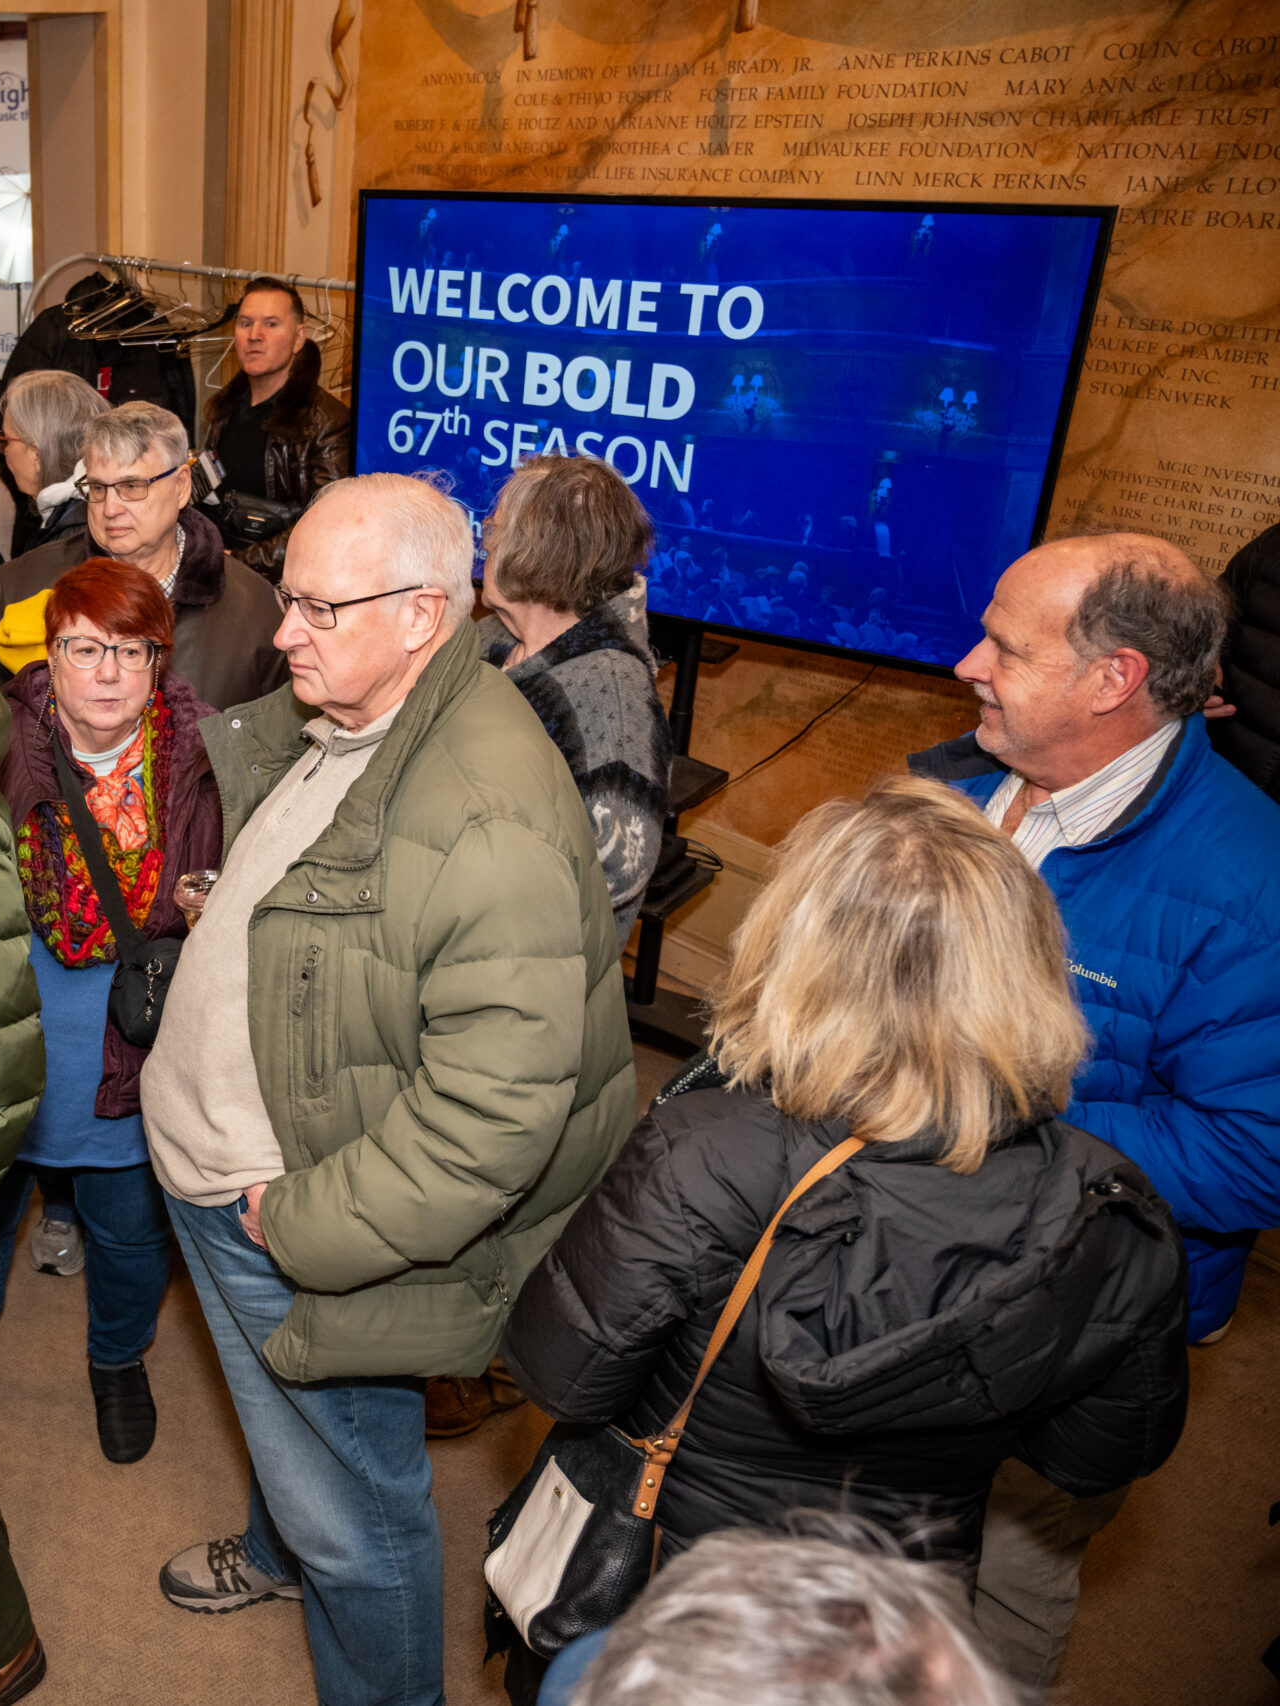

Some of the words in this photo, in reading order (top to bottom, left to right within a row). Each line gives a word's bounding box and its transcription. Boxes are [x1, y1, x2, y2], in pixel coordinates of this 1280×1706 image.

[838, 53, 896, 70] ANNE
[904, 49, 992, 68] PERKINS
[999, 45, 1075, 64] CABOT
[1103, 41, 1183, 61] COLIN
[1192, 35, 1280, 57] CABOT
[421, 71, 500, 86] ANONYMOUS
[517, 70, 530, 83] IN
[537, 67, 595, 82] MEMORY
[602, 66, 621, 79] OF
[627, 61, 696, 79] WILLIAM
[703, 61, 719, 75] H.
[727, 58, 785, 75] BRADY,
[792, 57, 814, 78] JR.
[699, 87, 758, 102] FOSTER
[766, 84, 829, 101] FAMILY
[837, 81, 968, 99] FOUNDATION
[1005, 78, 1072, 95] MARY
[1080, 76, 1137, 94] ANN
[1147, 75, 1166, 92] &
[1176, 72, 1264, 92] LLOYD
[515, 93, 549, 106] COLE
[552, 95, 562, 106] &
[618, 90, 672, 104] FOSTER
[394, 119, 435, 132] ROBERT
[452, 120, 461, 131] &
[465, 118, 498, 133] JEAN
[518, 117, 561, 131] HOLTZ
[566, 116, 598, 131] AND
[603, 115, 689, 130] MARIANNE
[695, 114, 747, 129] HOLTZ
[753, 113, 825, 129] EPSTEIN
[847, 111, 914, 131] JOSEPH
[920, 110, 1023, 131] JOHNSON
[1032, 108, 1185, 127] CHARITABLE
[1195, 107, 1274, 126] TRUST
[677, 142, 690, 156] C.
[698, 142, 754, 156] MAYER
[782, 141, 891, 158] MILWAUKEE
[898, 141, 1038, 159] FOUNDATION
[1076, 142, 1202, 160] NATIONAL
[606, 167, 635, 180] LIFE
[641, 168, 733, 183] INSURANCE
[739, 168, 825, 184] COMPANY
[855, 171, 905, 187] LINN
[912, 172, 985, 188] MERCK
[992, 173, 1088, 191] PERKINS
[1124, 175, 1187, 195] JANE
[1196, 178, 1215, 194] &
[1117, 207, 1194, 227] EATRE
[1205, 211, 1280, 230] BOAR
[388, 267, 662, 333] WELCOME
[680, 283, 765, 340] TO
[1166, 344, 1269, 366] CHAMBER
[392, 340, 510, 402] OUR
[522, 351, 696, 421] BOLD
[1083, 359, 1170, 380] NDATION,
[1181, 367, 1221, 385] INC.
[1089, 381, 1235, 409] STOLLENWERK
[387, 405, 471, 456] 67th
[481, 420, 695, 492] SEASON
[1158, 460, 1198, 476] MGIC
[1081, 466, 1203, 494] NORTHWESTERN
[1119, 489, 1148, 504] THE
[1153, 495, 1224, 516] CHARLES
[1230, 507, 1244, 520] D.
[1096, 503, 1105, 514] &
[1111, 505, 1143, 521] MRS.
[1189, 518, 1262, 540] POLLOCK
[1063, 959, 1118, 988] Columbia
